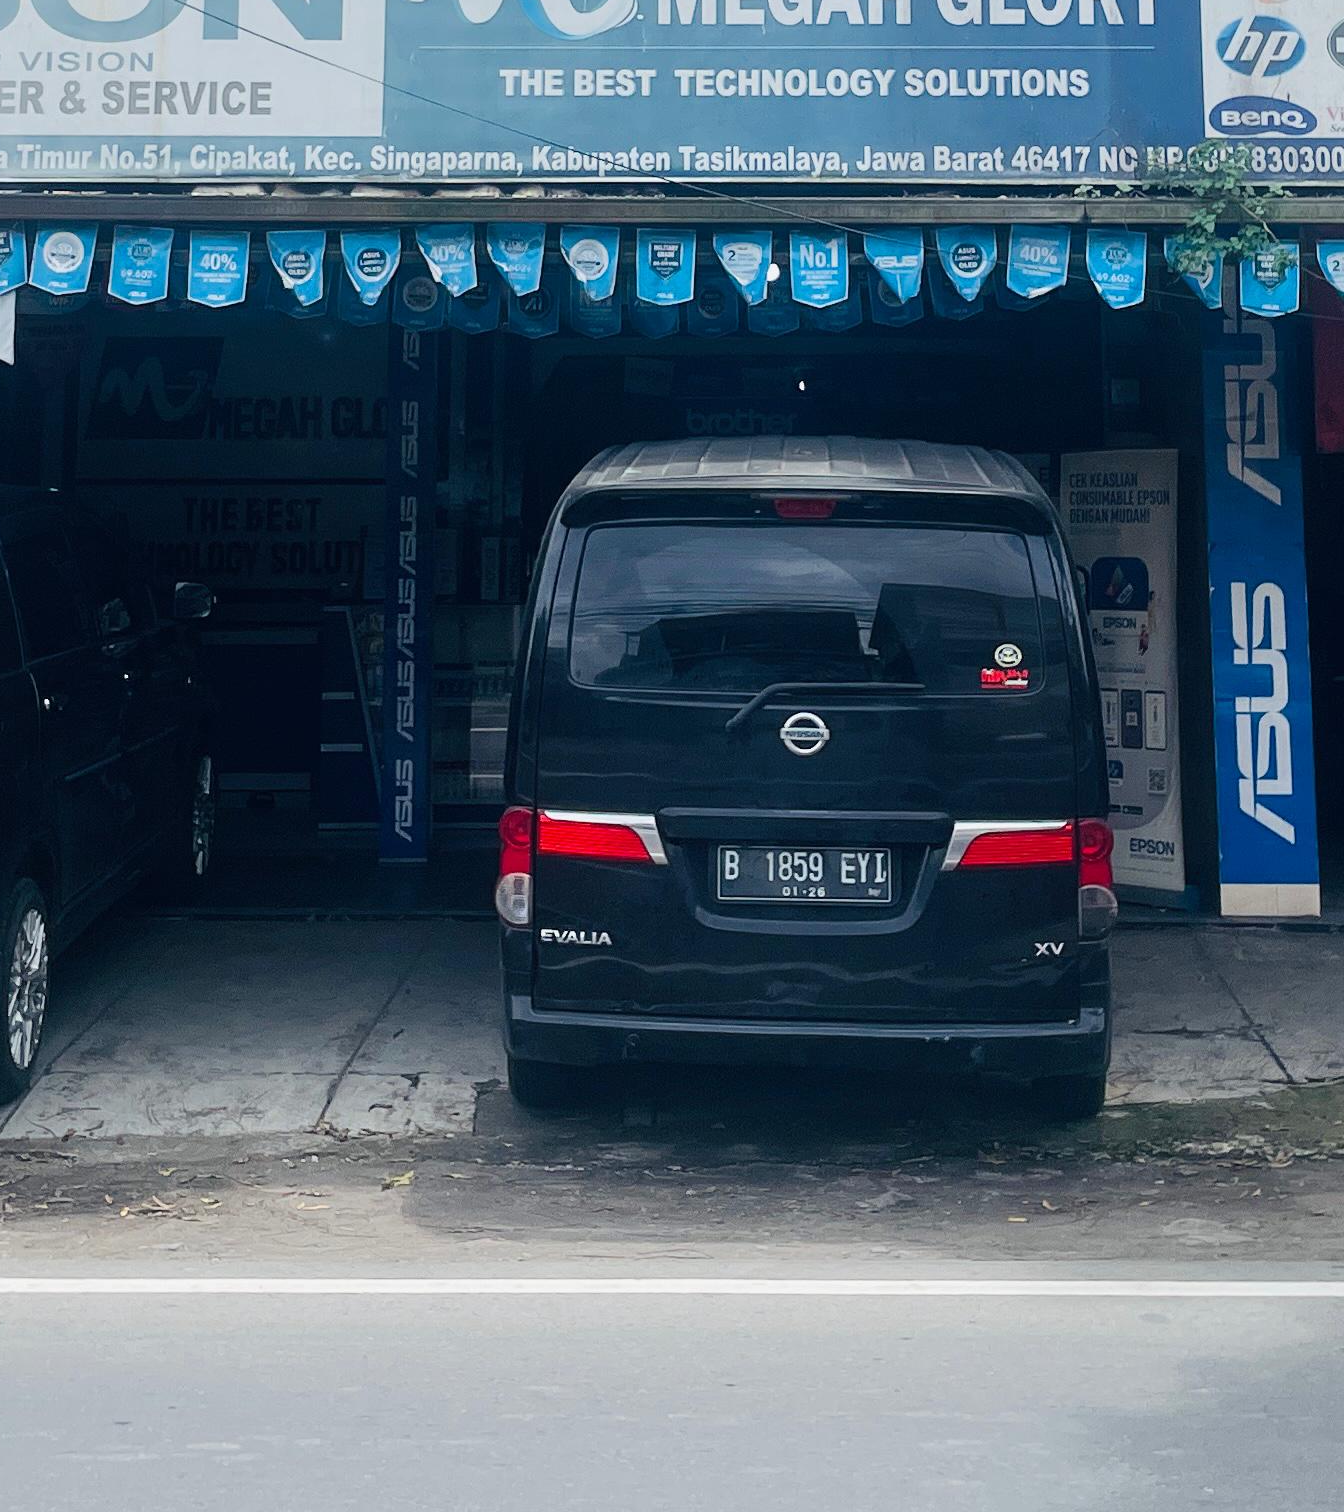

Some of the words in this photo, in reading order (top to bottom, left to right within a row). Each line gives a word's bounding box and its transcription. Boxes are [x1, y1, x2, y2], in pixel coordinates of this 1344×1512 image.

[1222, 14, 1302, 79] hp
[19, 48, 155, 73] VISION
[500, 69, 566, 97] THE
[574, 69, 656, 98] BEST
[675, 69, 897, 98] TECHNOLOGY
[904, 69, 1089, 98] SOLUTIONS
[58, 79, 87, 115] &
[100, 80, 272, 116] SERVICE
[1221, 110, 1307, 128] BenQ
[16, 146, 93, 172] Timur
[100, 146, 182, 176] No.51,
[189, 146, 295, 178] Cipakat,
[305, 146, 366, 172] Kec.
[372, 146, 523, 178] Singaparna,
[532, 147, 670, 178] Kabupaten
[678, 147, 847, 178] Tasikmalaya,
[856, 148, 926, 172] Jawa
[933, 148, 1004, 172] Barat
[1011, 148, 1091, 172] 46417
[200, 254, 236, 271] 40%
[429, 245, 464, 262] 40%
[728, 250, 736, 261] 2
[799, 239, 839, 268] No.1
[873, 255, 918, 268] ASUS
[958, 261, 978, 269] OLED
[1020, 245, 1057, 264] 40%
[1332, 260, 1340, 271] 2
[208, 397, 322, 439] MEGAH
[331, 398, 387, 438] GLO
[687, 408, 797, 434] brother
[401, 400, 419, 479] ASUS
[1069, 473, 1087, 488] CEK
[1090, 472, 1138, 488] KEASLIAN
[1069, 490, 1134, 506] CONSUMABLE
[1137, 489, 1170, 505] EPSON
[183, 497, 244, 535] THE
[252, 497, 322, 534] BEST
[400, 496, 417, 576] ASUS
[398, 578, 416, 662] ASUS
[1103, 616, 1137, 630] EPSON
[396, 660, 415, 742] ASUS
[1230, 582, 1296, 845] ASUS
[784, 730, 827, 738] NISSAN
[394, 758, 413, 843] ASUS
[1130, 838, 1175, 855] EPSON
[724, 850, 740, 880] B
[766, 851, 824, 882] 1859
[540, 929, 612, 946] EVALIA
[1035, 941, 1065, 956] XV
